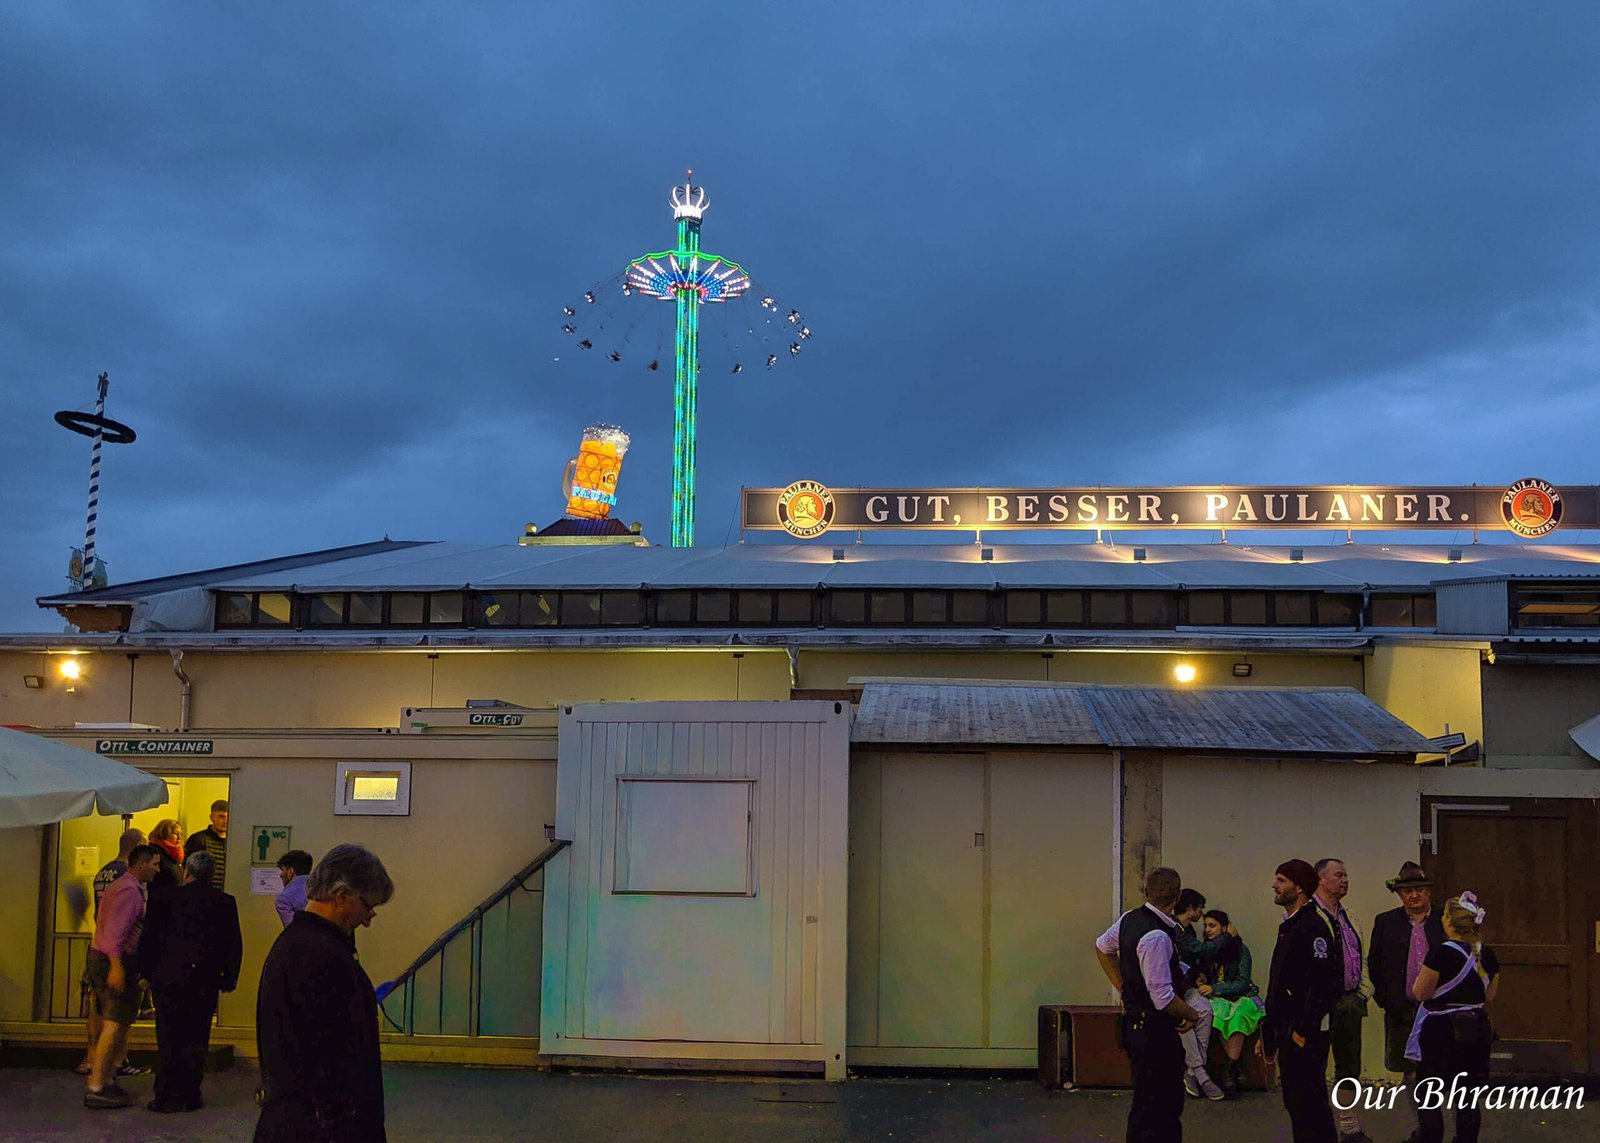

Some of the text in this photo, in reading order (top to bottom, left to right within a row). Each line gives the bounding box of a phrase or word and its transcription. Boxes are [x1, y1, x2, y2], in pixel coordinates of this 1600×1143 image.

[780, 482, 832, 505] PAULANER
[1503, 479, 1560, 504] PAULANER
[865, 493, 1469, 526] GUT, BESSER, PAULANER.
[271, 830, 287, 839] WC
